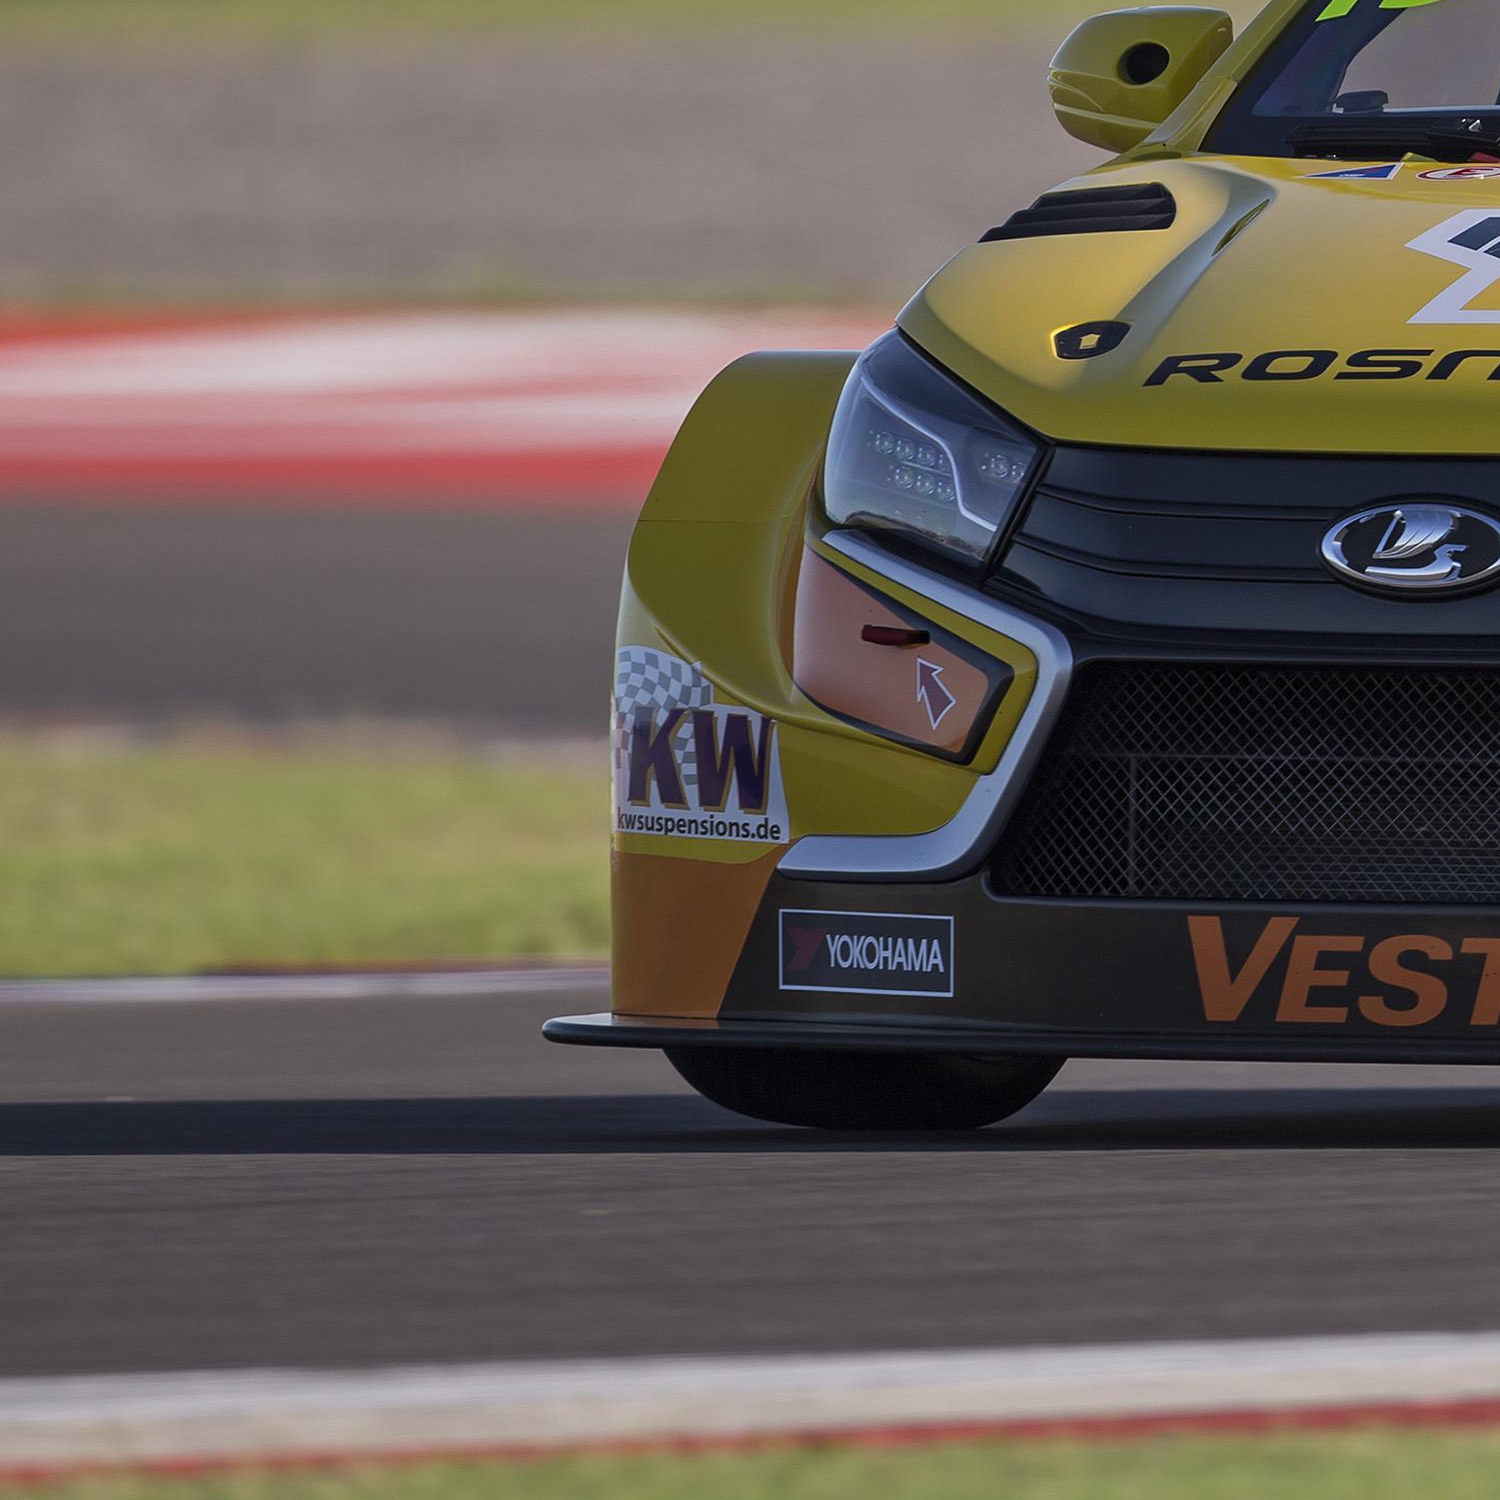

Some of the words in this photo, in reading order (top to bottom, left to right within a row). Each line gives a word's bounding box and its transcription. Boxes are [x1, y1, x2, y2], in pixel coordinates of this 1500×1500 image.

[627, 706, 776, 814] KW
[617, 807, 781, 840] kwsuspensions.de
[826, 934, 945, 972] YOKOHAMA
